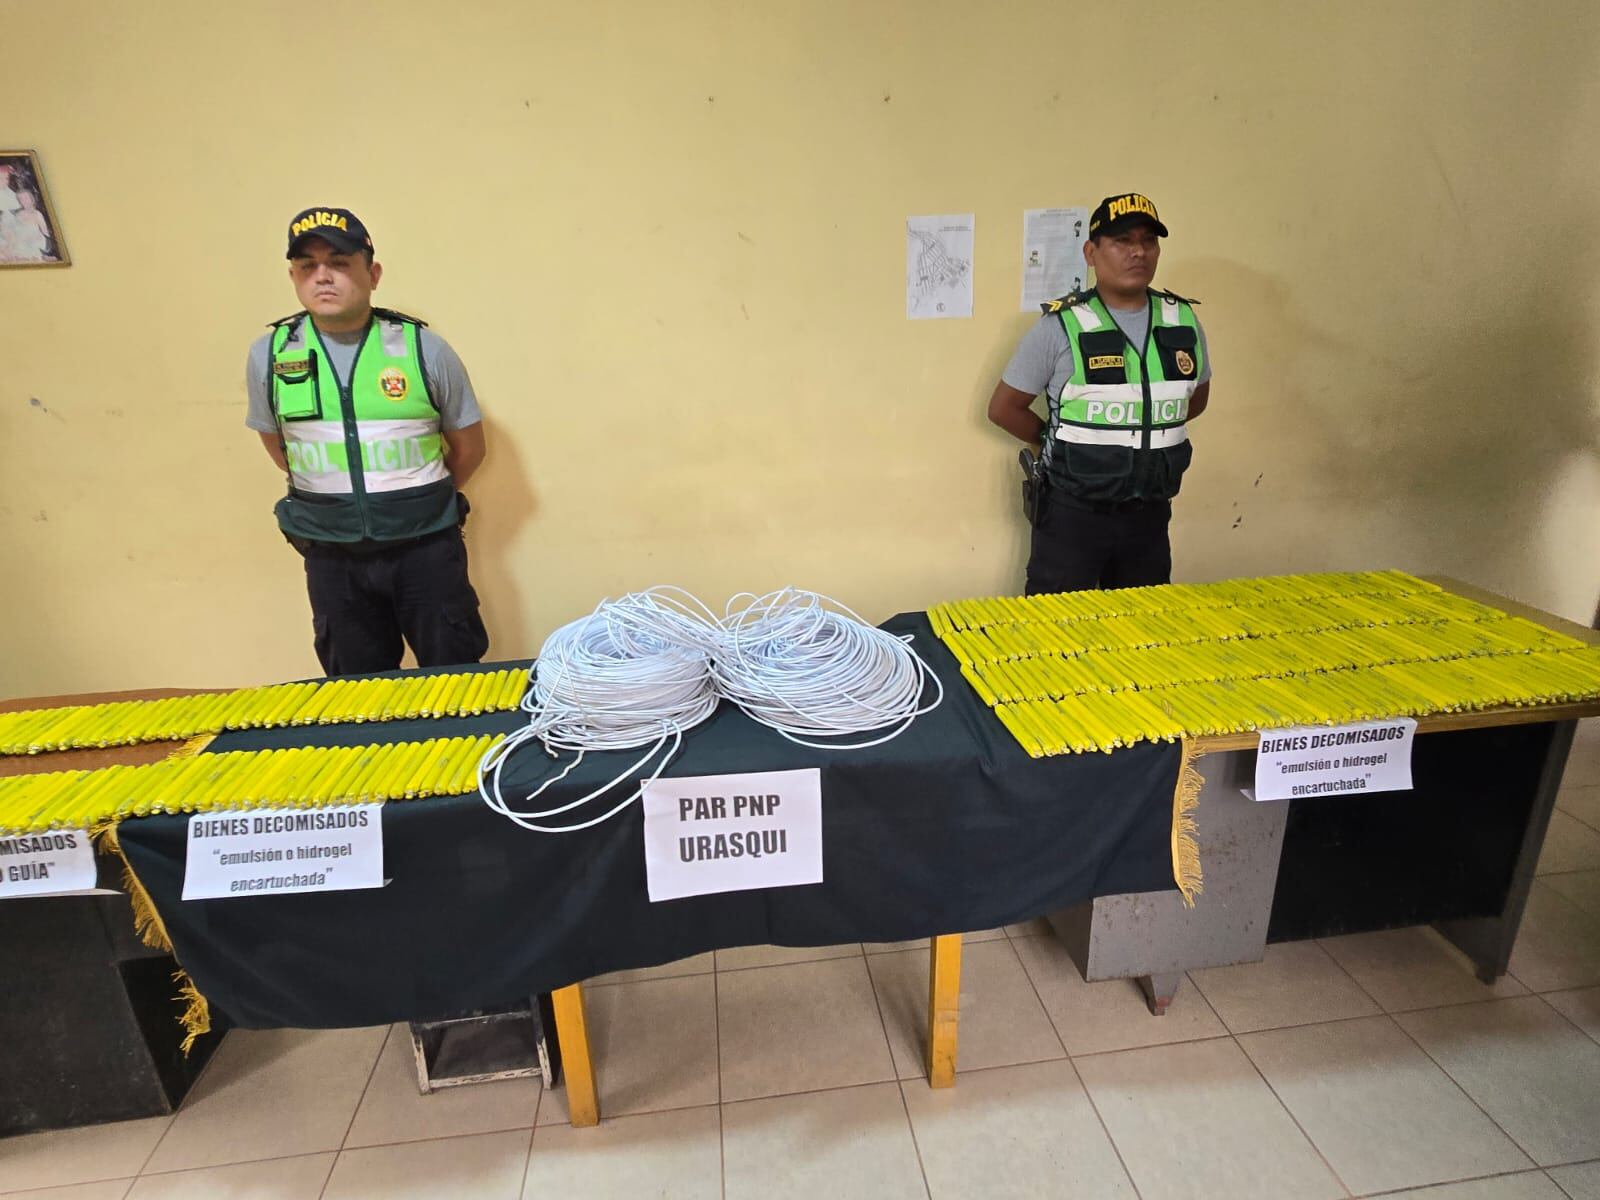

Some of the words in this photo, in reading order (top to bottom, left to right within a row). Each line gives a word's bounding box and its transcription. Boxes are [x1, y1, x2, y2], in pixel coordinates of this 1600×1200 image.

[292, 211, 347, 237] POLICIA
[1262, 736, 1308, 753] BIENES
[1311, 726, 1406, 749] DECOMISADOS
[1334, 760, 1340, 769] o
[1343, 753, 1387, 766] hidrogel
[1292, 773, 1371, 795] encartuchada”
[679, 796, 727, 821] PAR
[733, 795, 780, 817] PNP
[193, 817, 249, 838] BIENES
[253, 811, 368, 834] DECOMISADOS
[286, 849, 293, 860] o
[297, 843, 352, 859] hidrogel
[679, 829, 787, 862] URASQUI
[230, 868, 333, 892] encartuchada”
